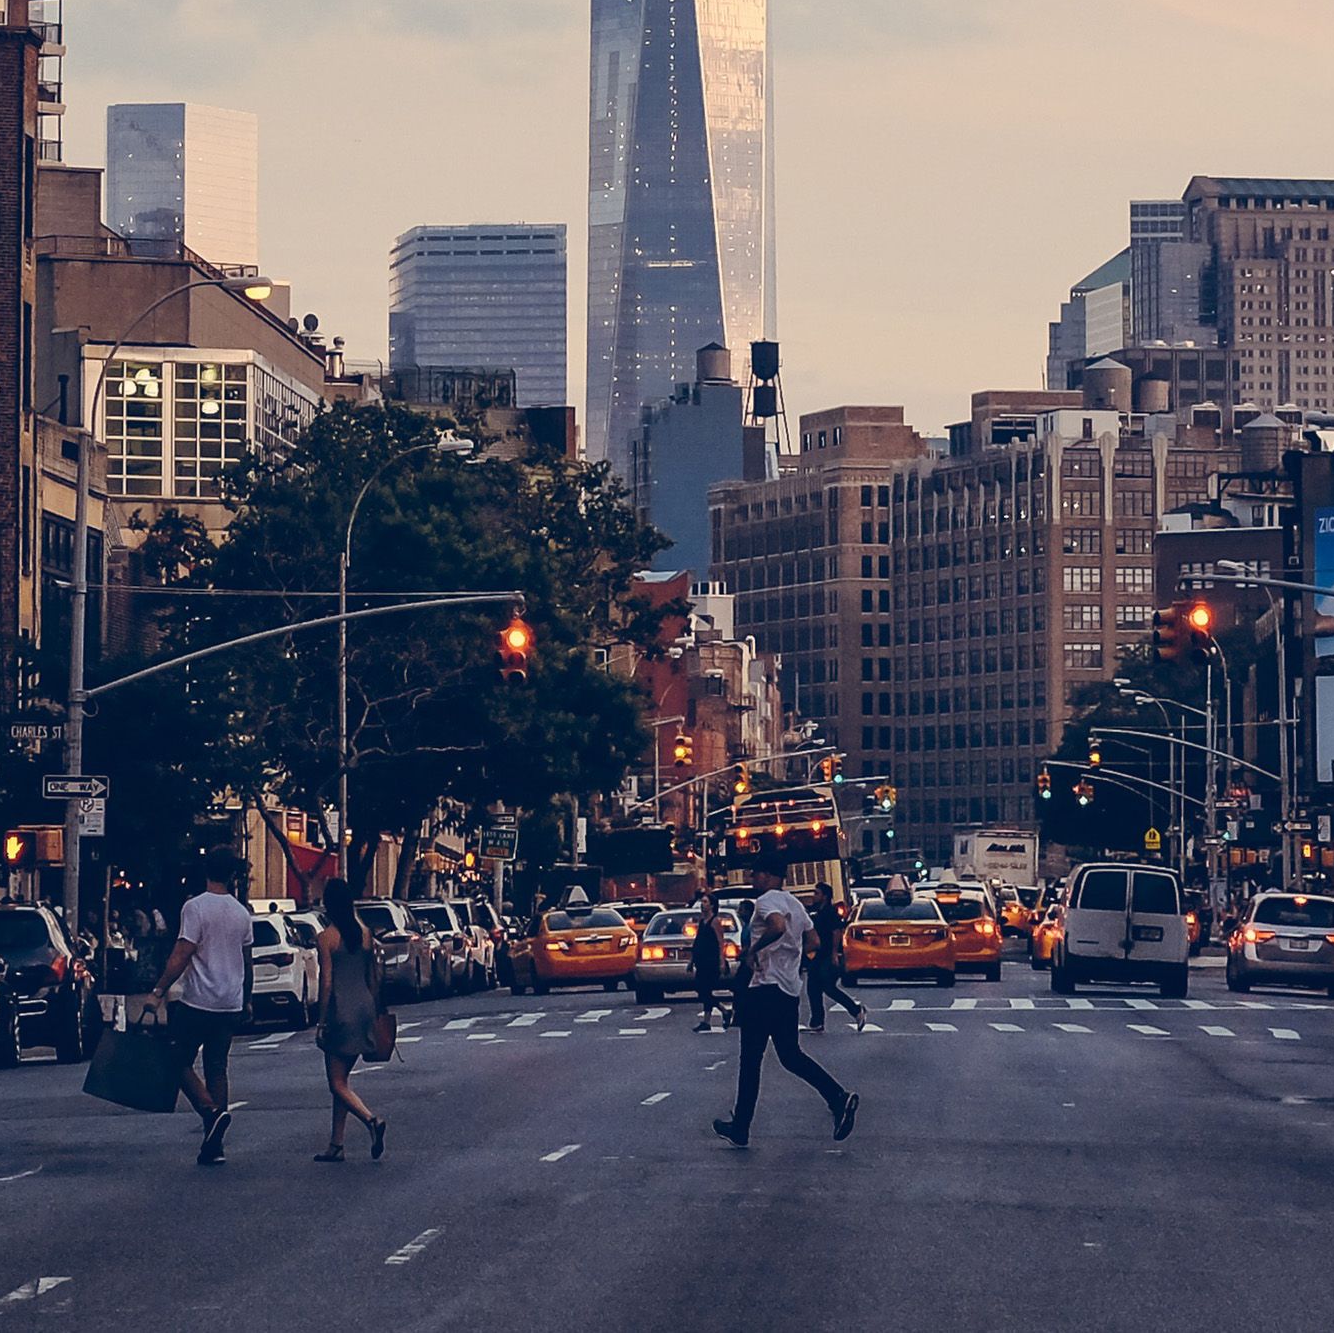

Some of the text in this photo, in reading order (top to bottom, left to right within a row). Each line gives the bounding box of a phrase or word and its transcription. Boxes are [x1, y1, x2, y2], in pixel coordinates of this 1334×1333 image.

[10, 725, 62, 739] CHARLES ST
[49, 782, 99, 791] ONE WAY
